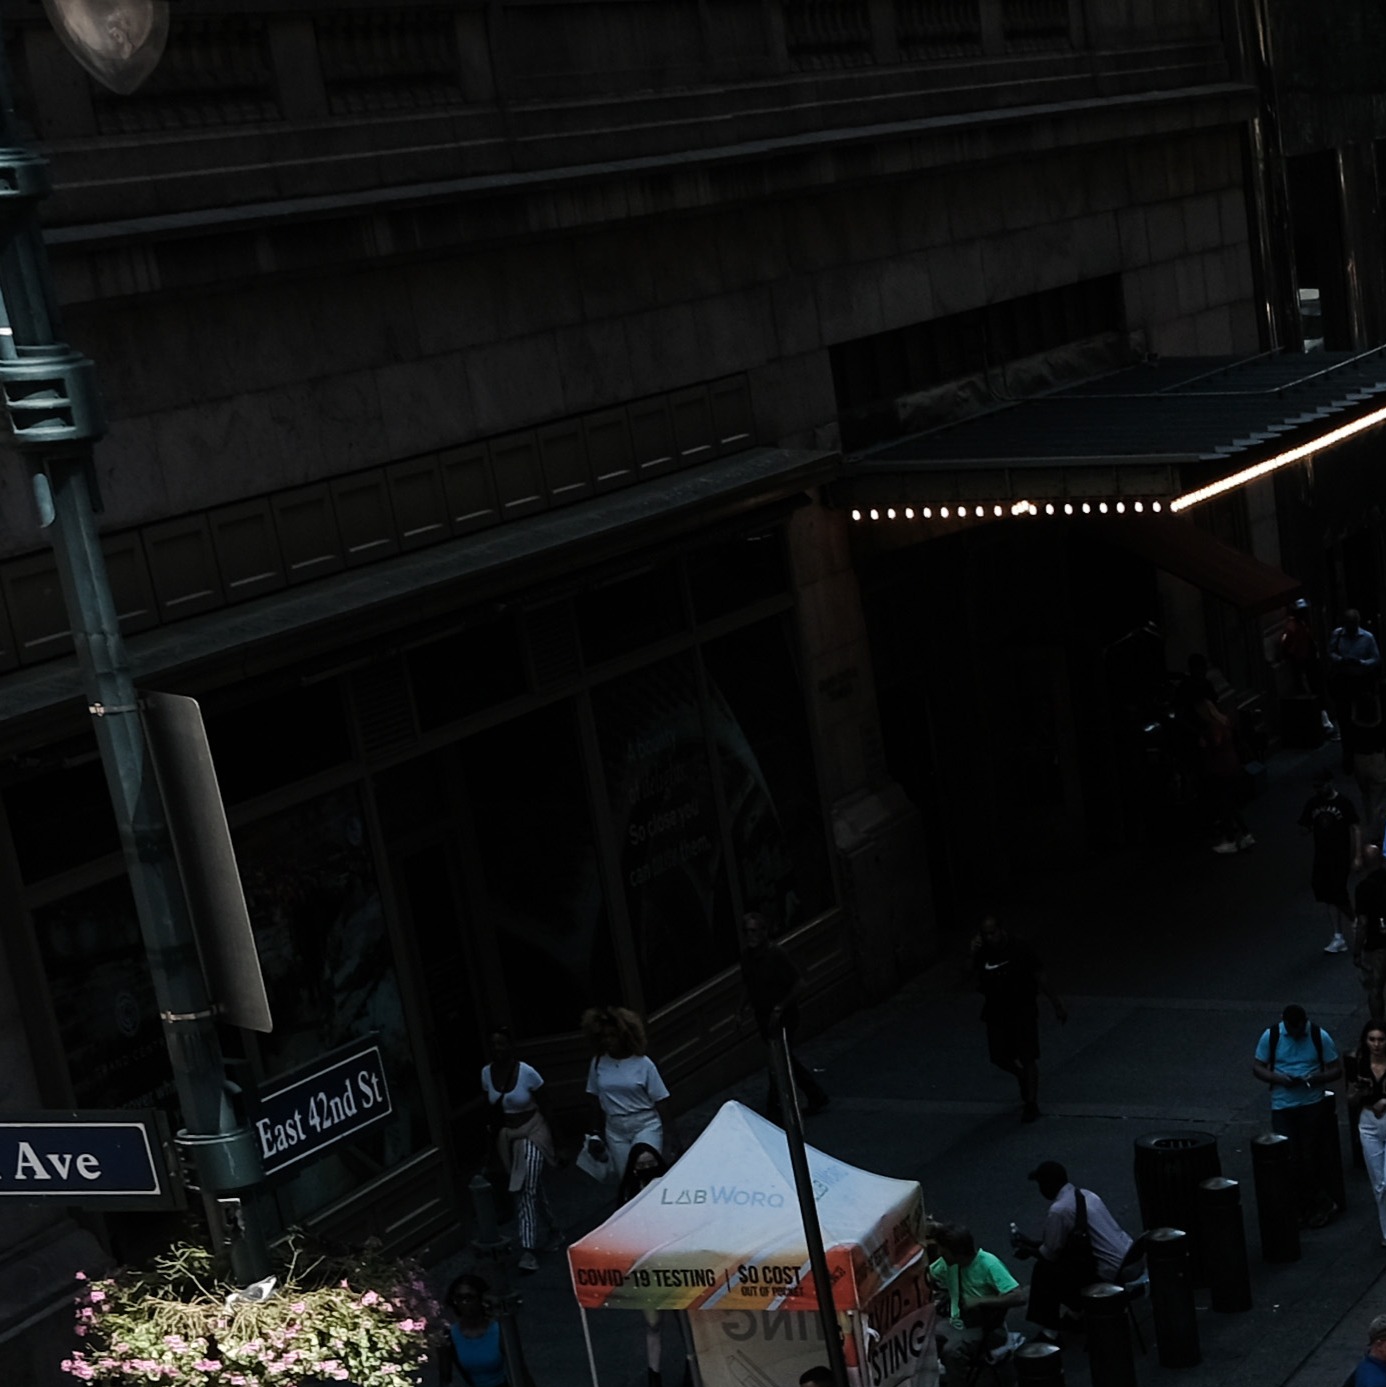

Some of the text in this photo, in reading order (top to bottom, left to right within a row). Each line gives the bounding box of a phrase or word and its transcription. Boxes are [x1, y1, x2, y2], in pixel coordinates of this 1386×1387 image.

[256, 1070, 384, 1160] East 42nd St
[14, 1141, 102, 1181] Ave
[578, 1268, 649, 1288] COVID-19
[653, 1269, 716, 1288] TESTING
[762, 1265, 801, 1284] COST
